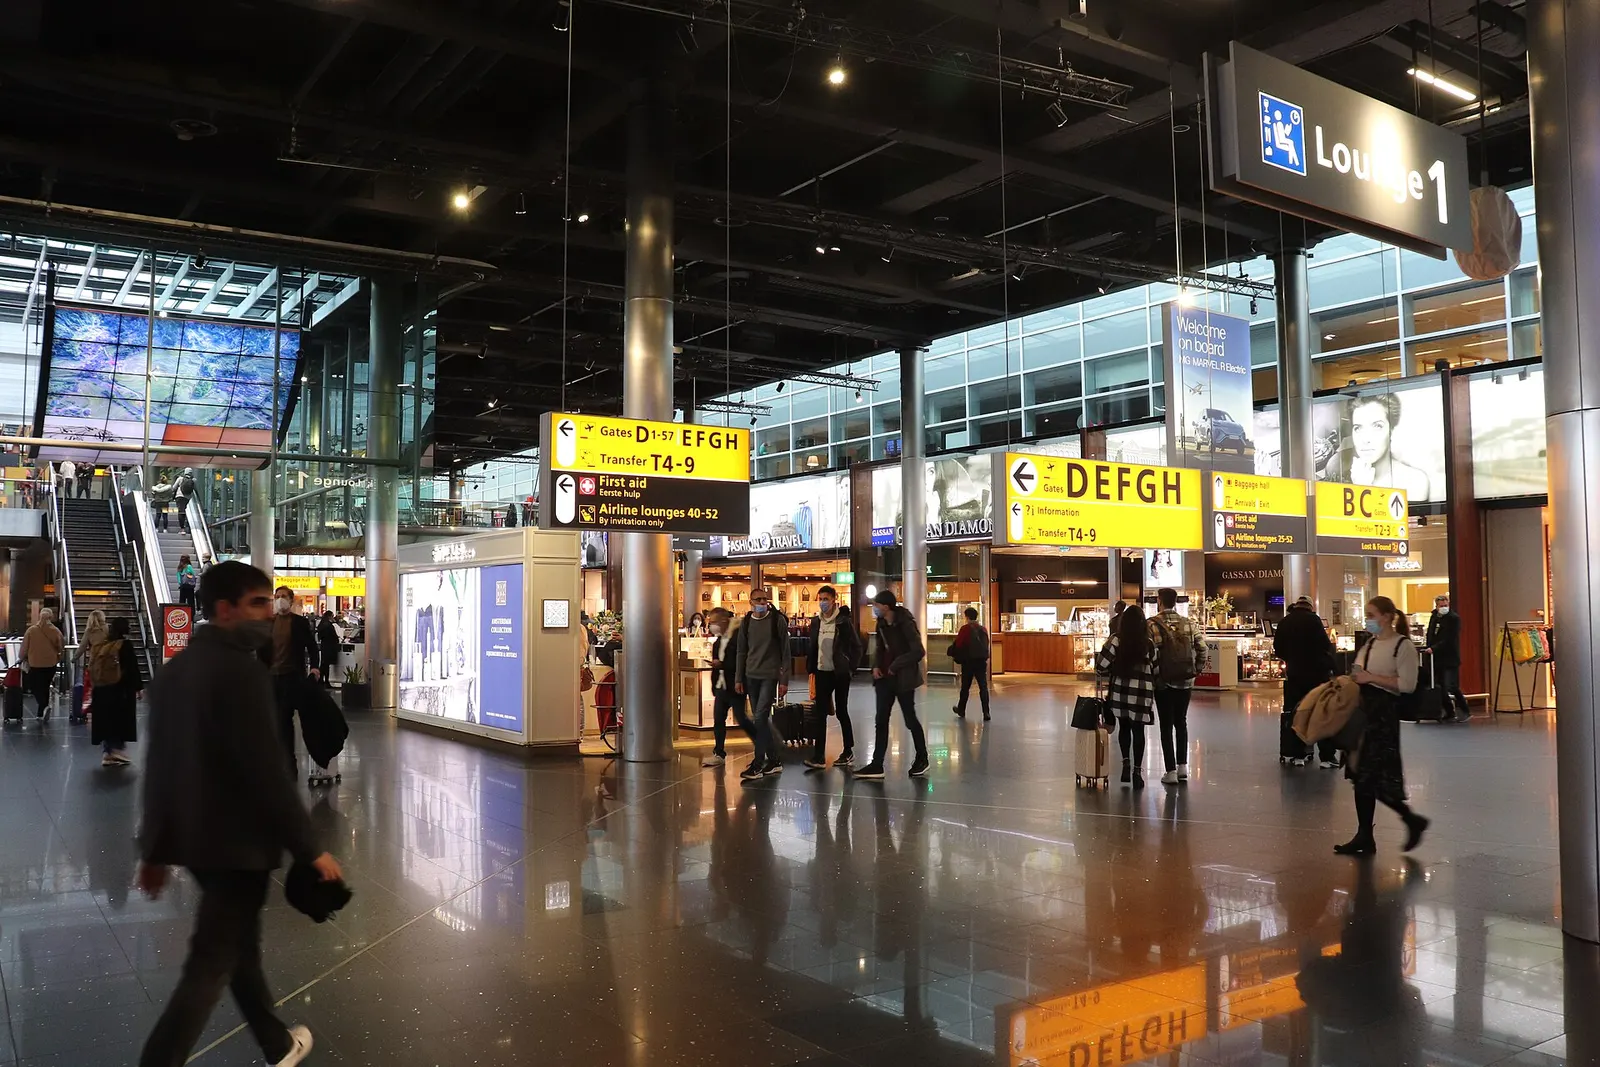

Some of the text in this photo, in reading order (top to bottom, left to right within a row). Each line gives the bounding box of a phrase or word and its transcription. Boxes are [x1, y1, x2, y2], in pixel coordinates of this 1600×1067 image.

[1428, 160, 1448, 224] 1
[1177, 316, 1226, 340] Welcome
[1178, 337, 1224, 356] on board
[1192, 357, 1220, 370] MARVEL
[1226, 363, 1246, 374] Electric
[601, 426, 632, 438] Gates
[636, 426, 649, 442] D
[652, 431, 674, 441] 1-57
[600, 453, 695, 473] Transfer T4-9
[600, 476, 647, 489] First aid
[1235, 480, 1258, 490] Baggage
[600, 489, 640, 499] Eerste hulp
[1044, 484, 1064, 494] Gates
[1235, 499, 1270, 508] Arrivals Exit
[600, 504, 718, 520] Airline lounges 40-52
[1038, 507, 1080, 517] Information
[599, 517, 664, 528] By invitation only
[1235, 514, 1258, 522] First aid
[1038, 528, 1097, 542] Transfer T4-9
[1374, 524, 1390, 536] T2-3
[728, 538, 760, 552] FASHION
[771, 534, 803, 548] TRAVEL
[1236, 533, 1293, 544] Airline lounges 25-52
[1384, 561, 1421, 569] OMEGA
[1222, 570, 1255, 579] GASSAN
[166, 632, 188, 640] WE'RE
